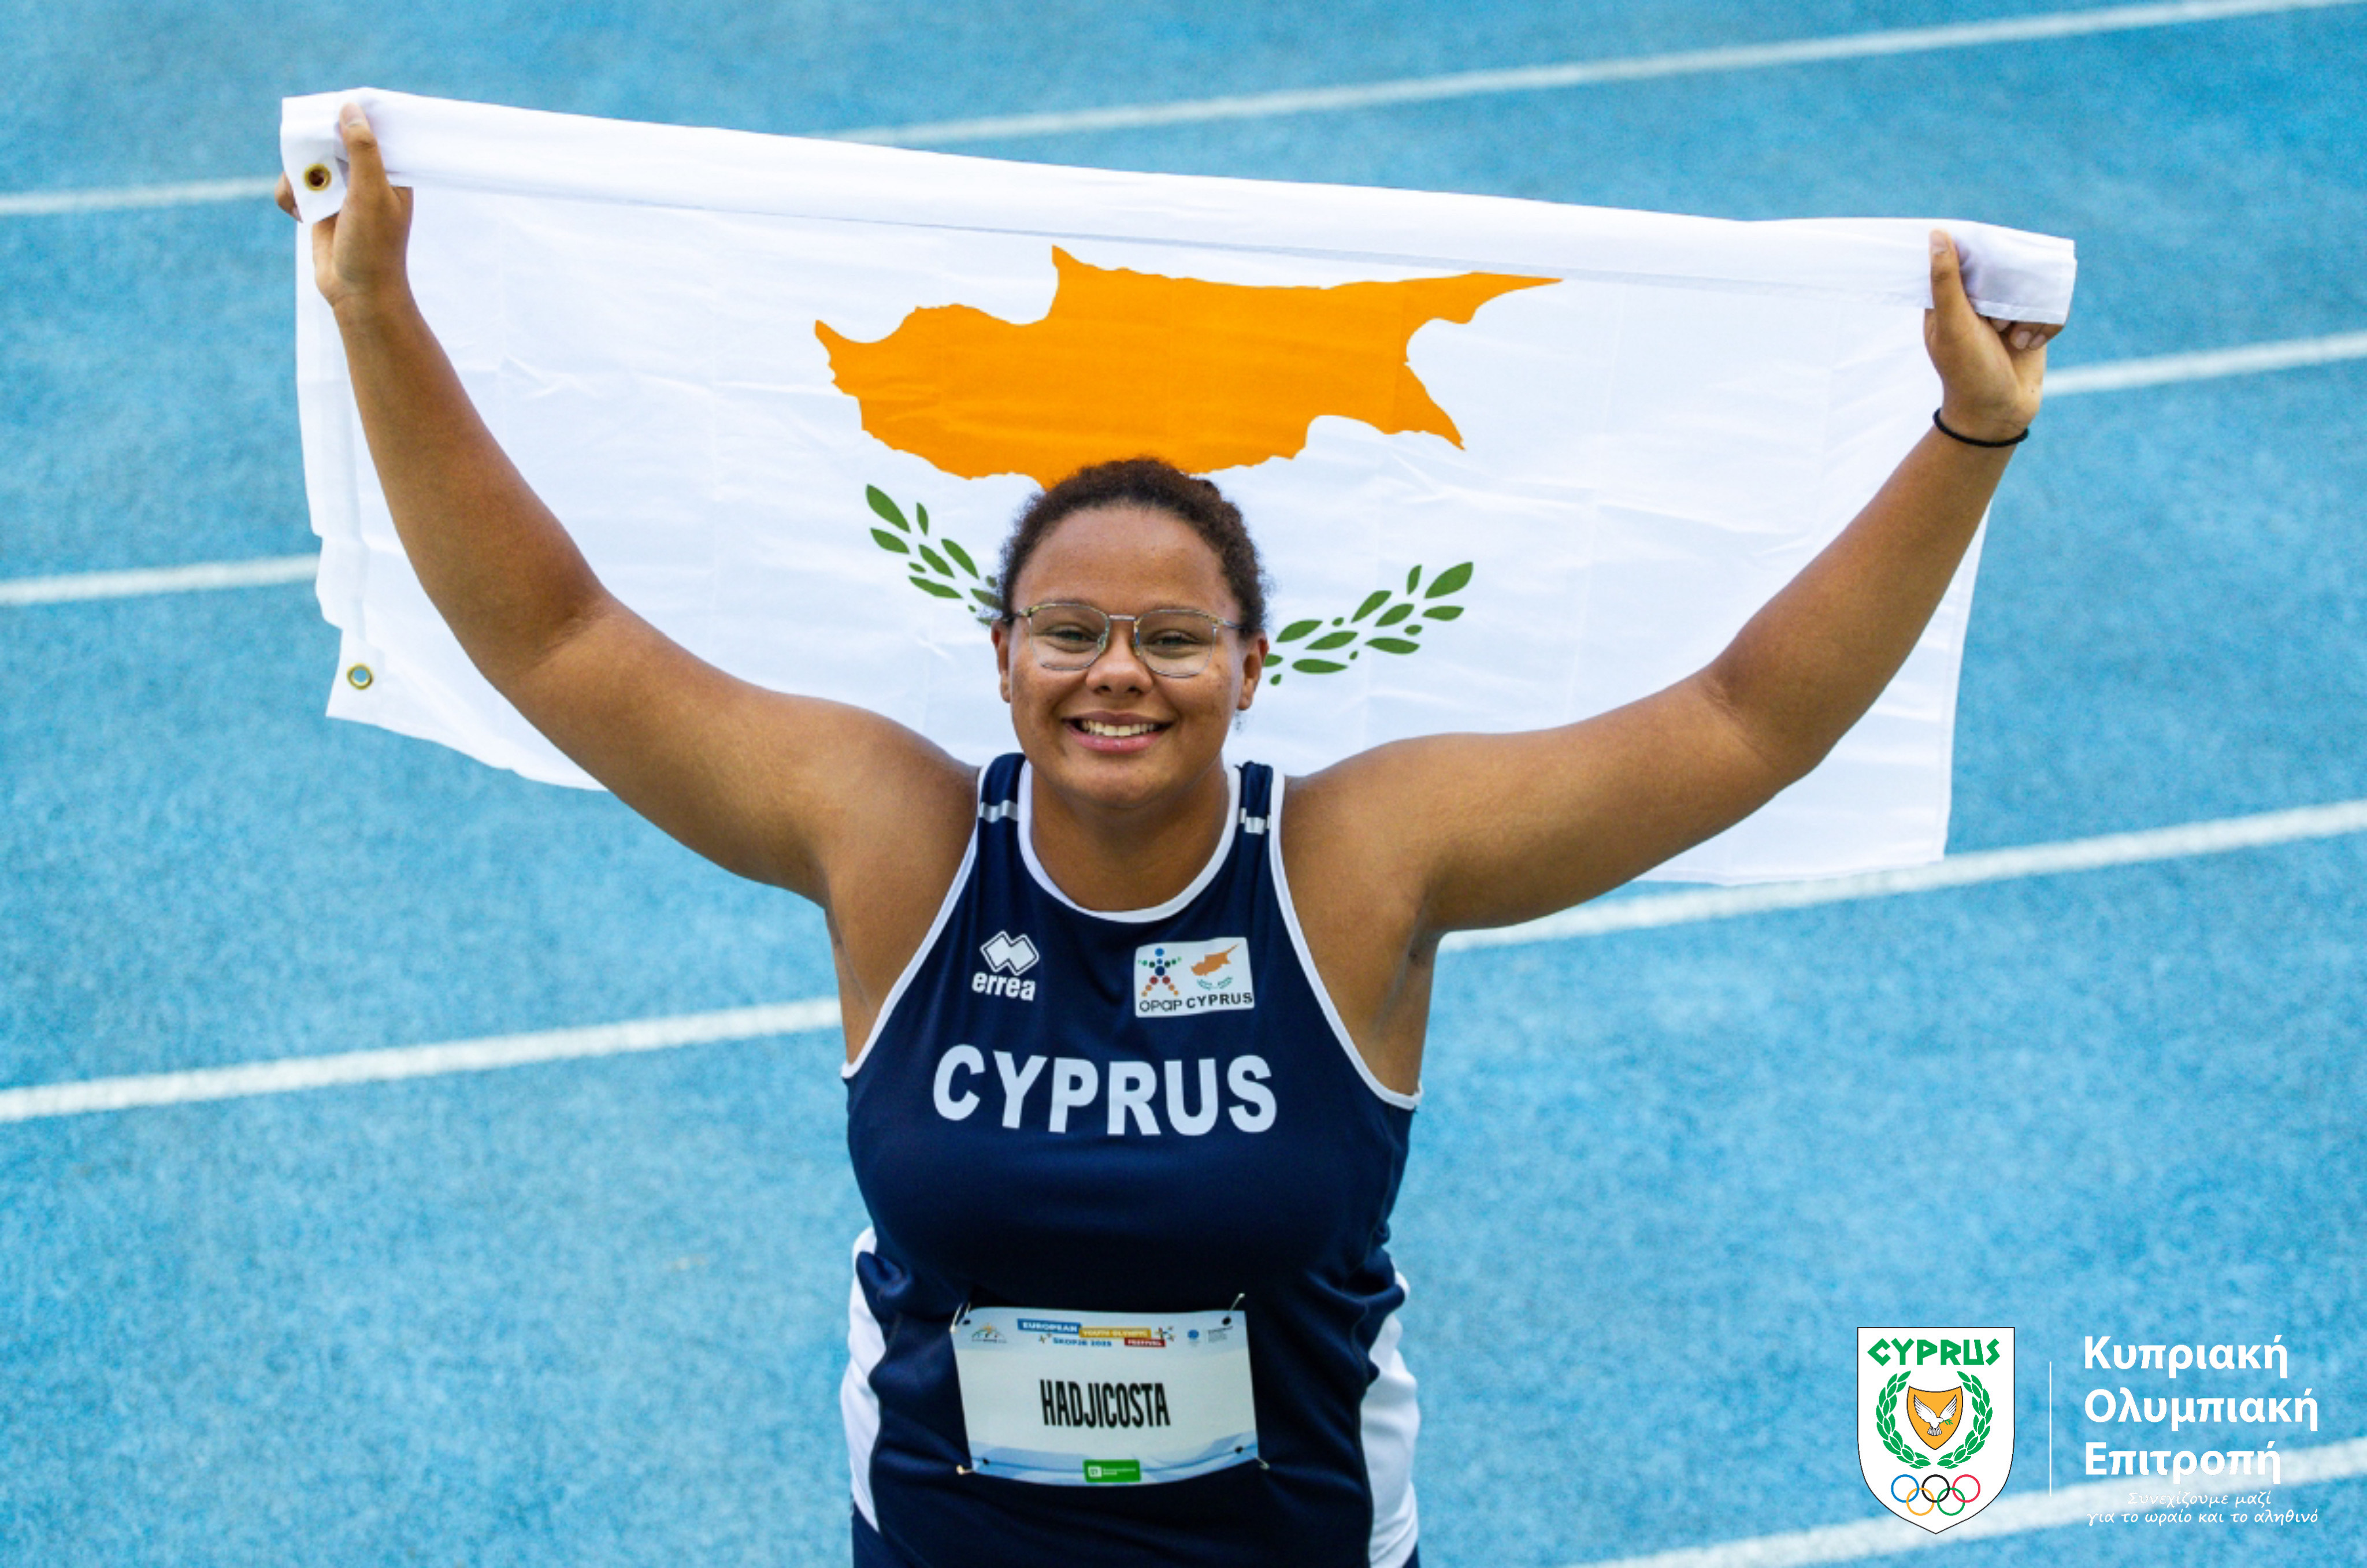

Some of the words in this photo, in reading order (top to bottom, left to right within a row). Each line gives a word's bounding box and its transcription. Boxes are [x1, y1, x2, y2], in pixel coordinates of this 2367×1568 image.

[1186, 992, 1253, 1009] CYPRUS
[933, 1043, 1278, 1136] CYPRUS
[1022, 1321, 1078, 1333] EUROPEAN
[1040, 1379, 1170, 1428] HADJICOSTA
